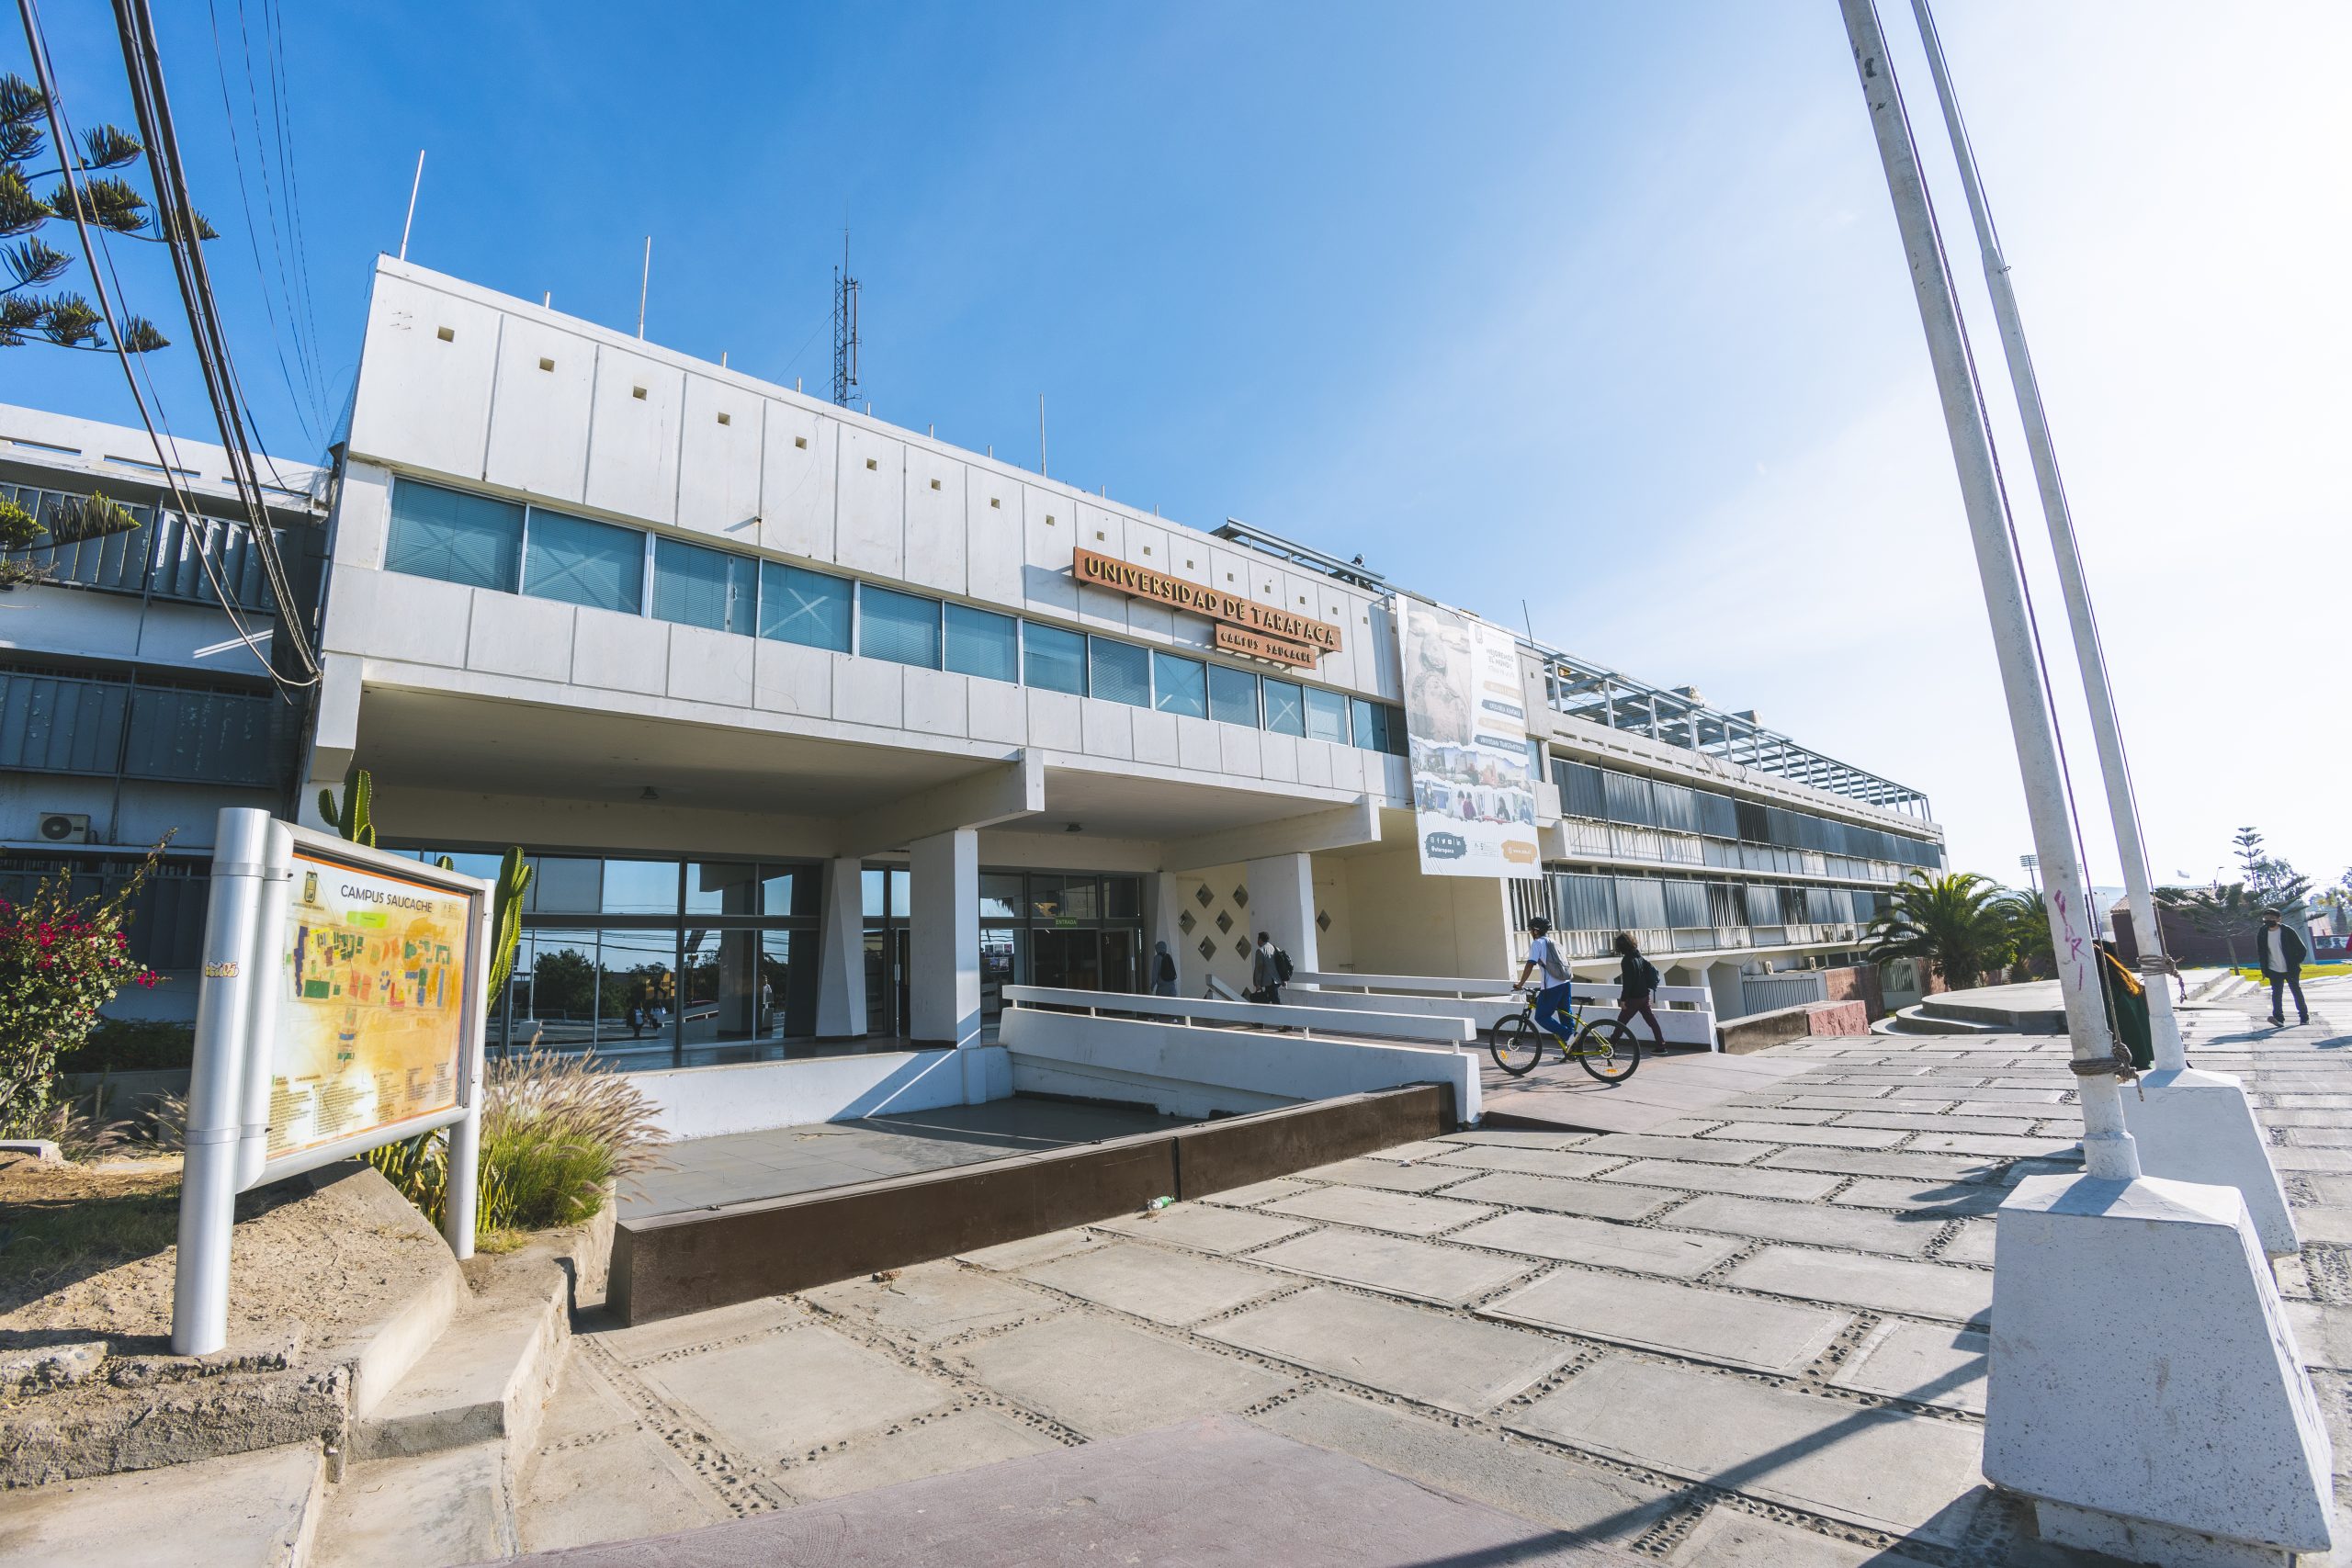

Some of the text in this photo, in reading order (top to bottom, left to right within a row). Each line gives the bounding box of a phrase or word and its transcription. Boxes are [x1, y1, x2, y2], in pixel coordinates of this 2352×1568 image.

[1085, 557, 1335, 646] UNIVERSIDAD DE TARAPACA
[1221, 632, 1312, 663] CAMPUS SAUCACHE
[341, 885, 384, 903] CAMPUS
[386, 894, 433, 913] SAUCACHE
